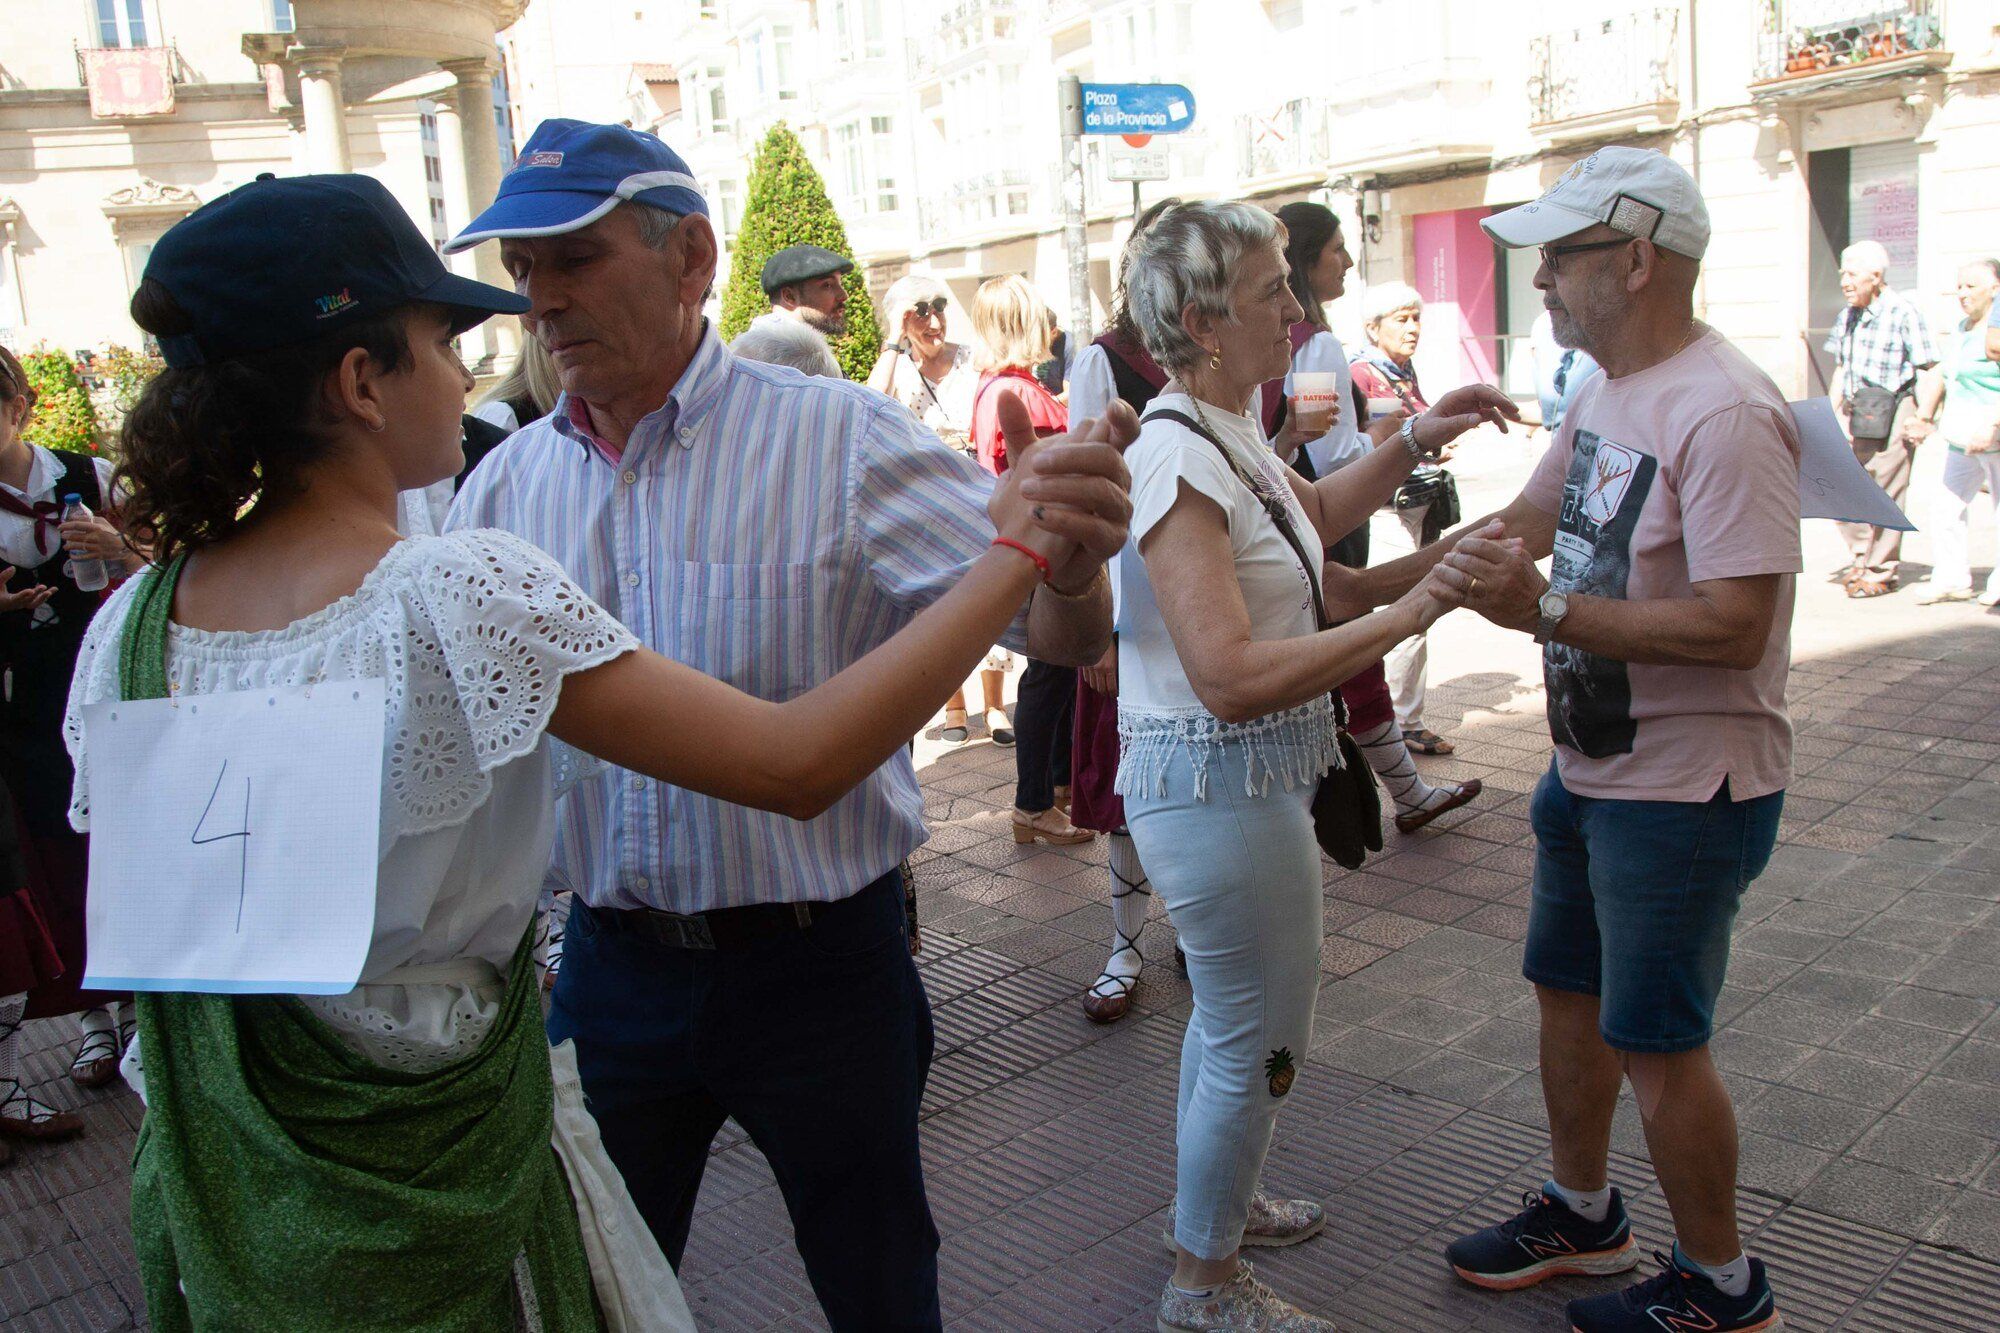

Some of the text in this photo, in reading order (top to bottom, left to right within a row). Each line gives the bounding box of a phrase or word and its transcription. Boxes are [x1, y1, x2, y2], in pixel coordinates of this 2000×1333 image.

[1085, 91, 1118, 106] Plaza
[1086, 112, 1167, 126] de la Provincia
[1613, 201, 1632, 225] YOUR
[191, 757, 251, 935] 4
